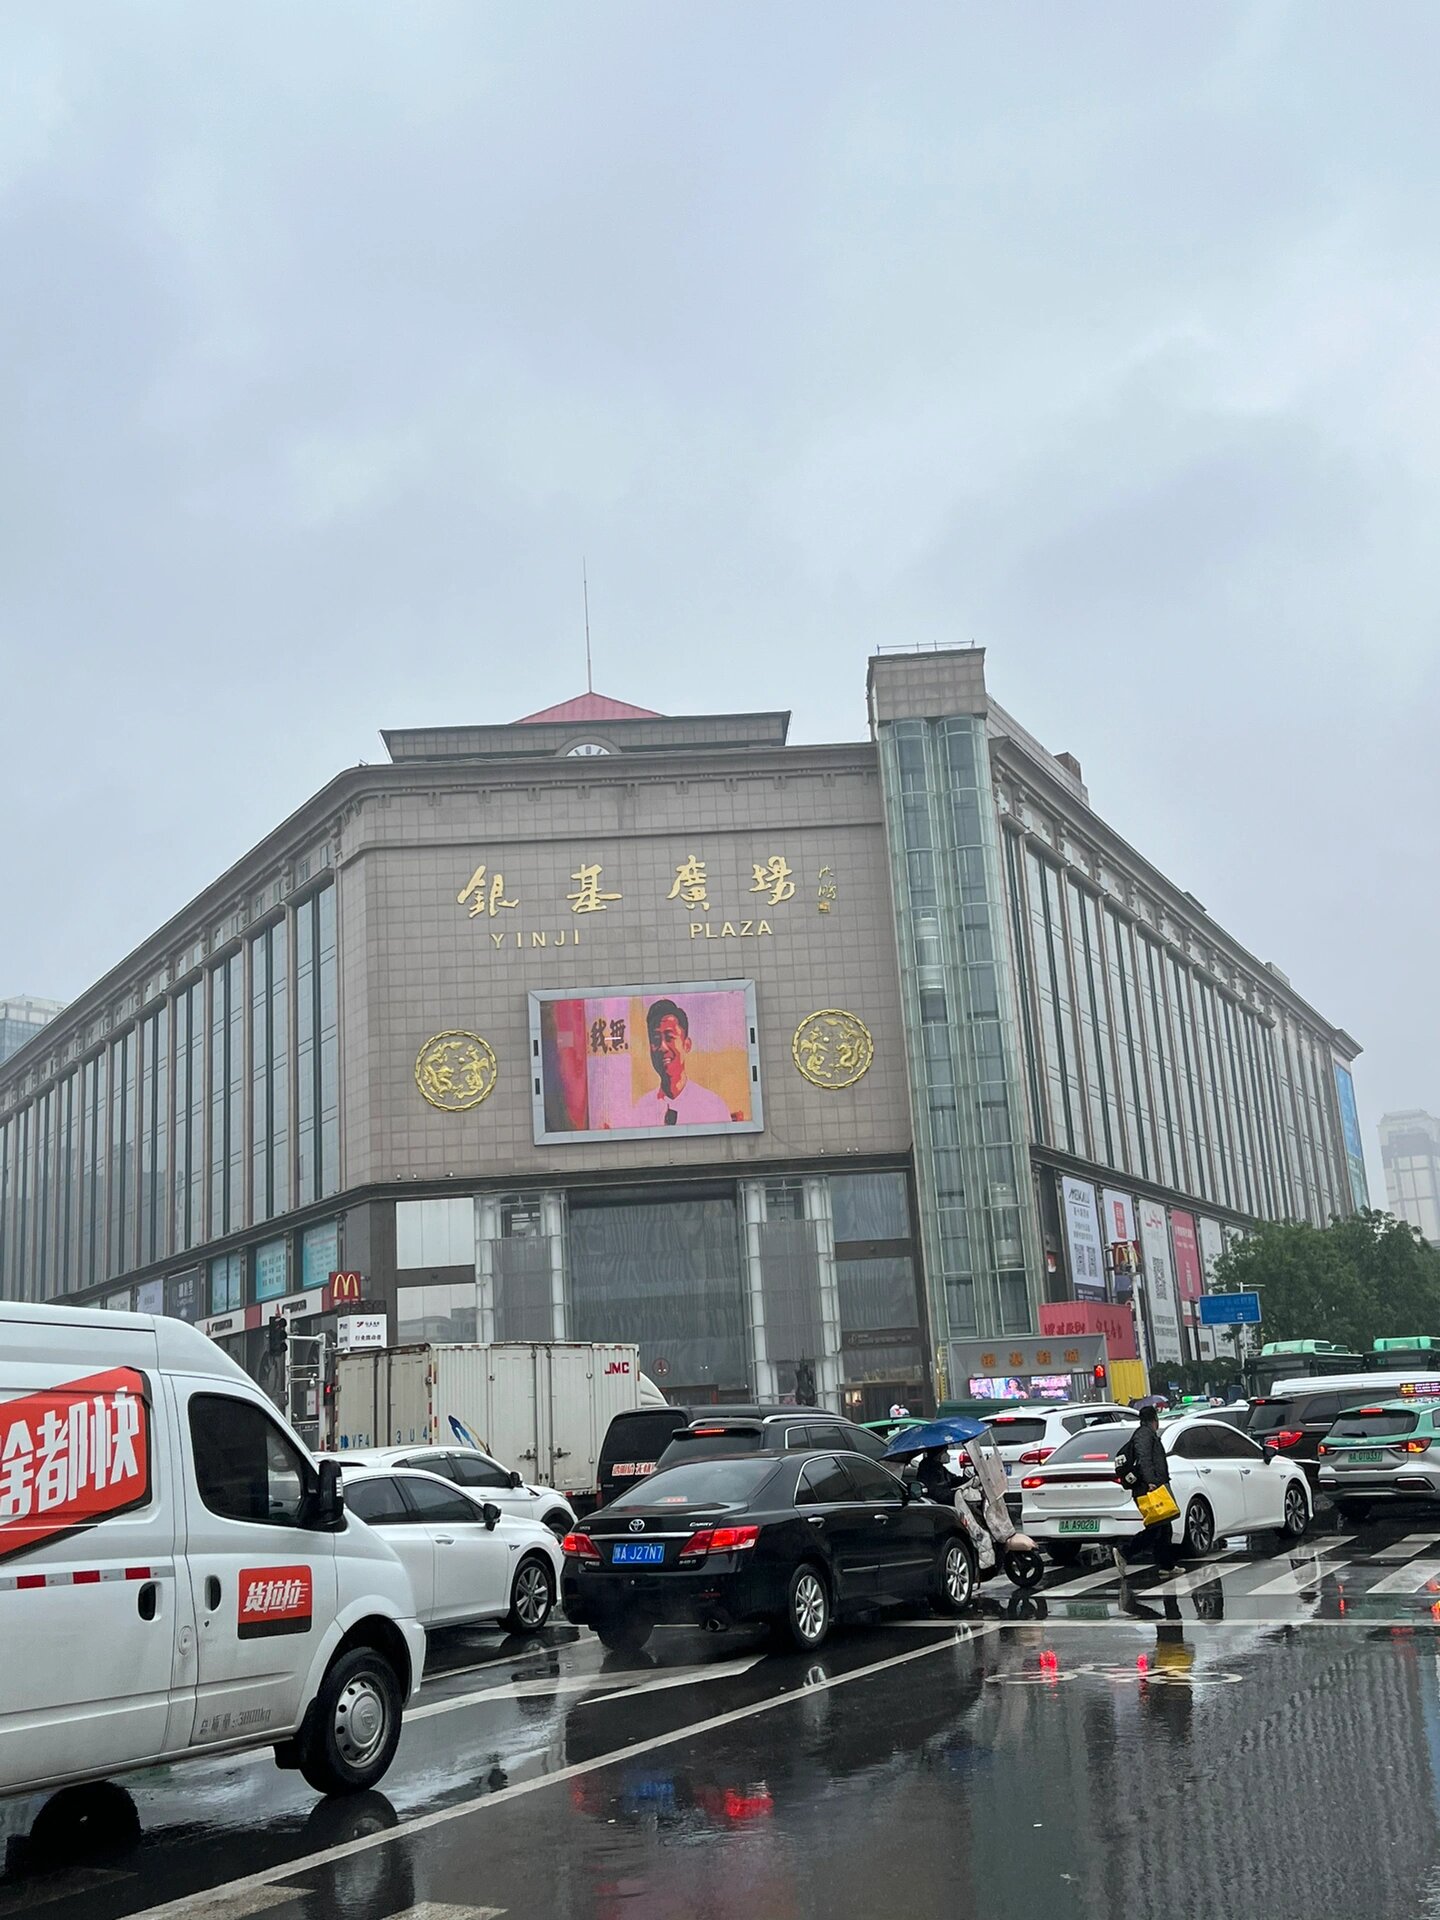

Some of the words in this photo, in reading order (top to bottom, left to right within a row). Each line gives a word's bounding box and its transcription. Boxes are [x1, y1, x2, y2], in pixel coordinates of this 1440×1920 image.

[490, 928, 580, 949] YINJI
[690, 919, 773, 939] PLAZA
[605, 1362, 629, 1375] JMC
[243, 1579, 304, 1613] 货拉拉
